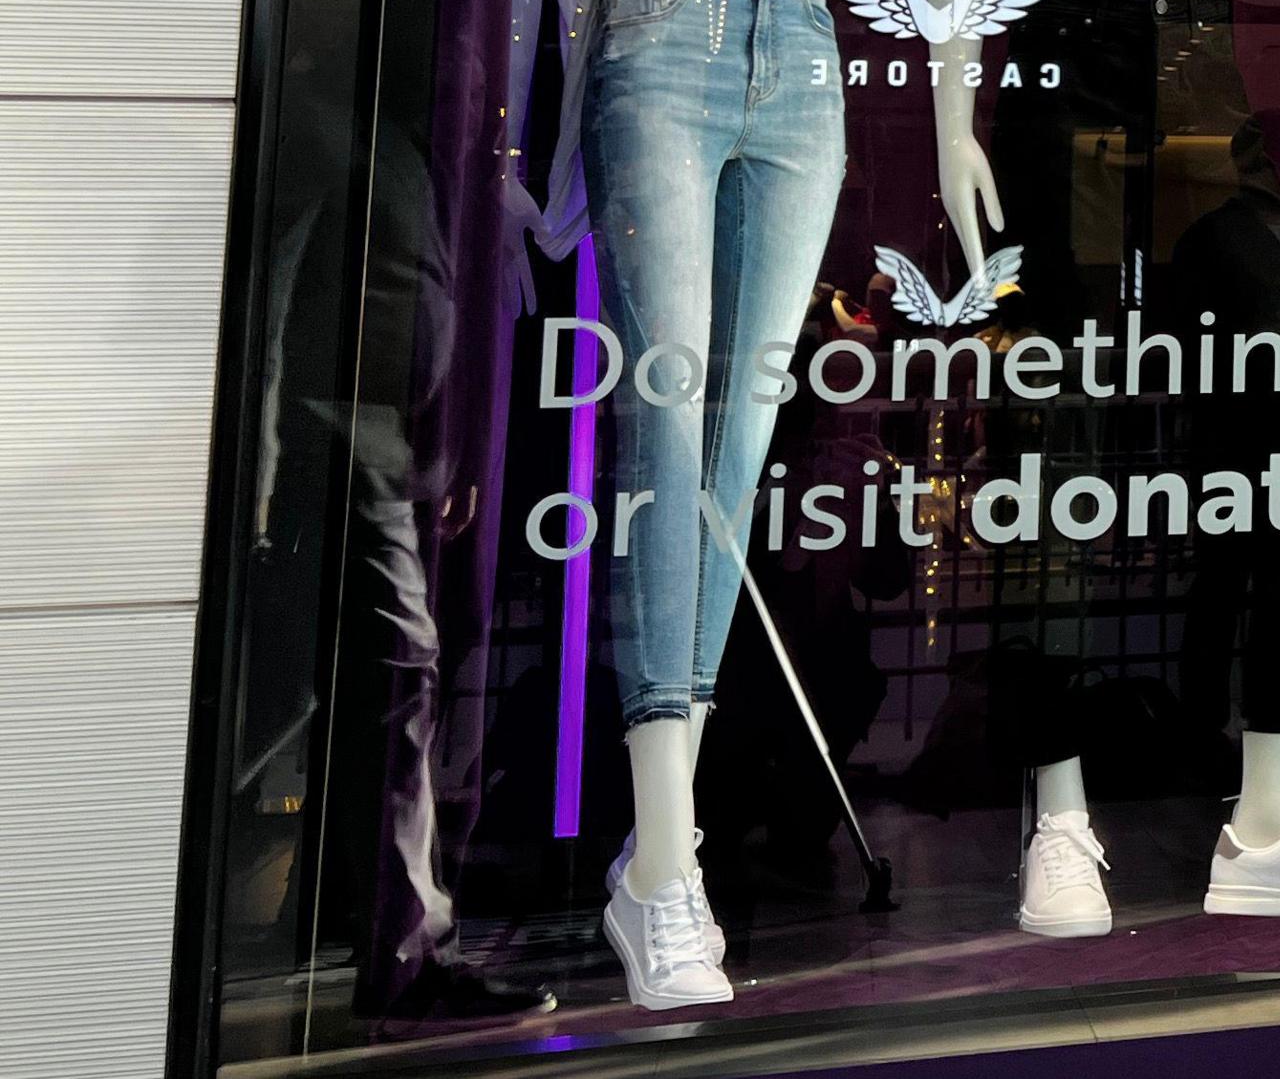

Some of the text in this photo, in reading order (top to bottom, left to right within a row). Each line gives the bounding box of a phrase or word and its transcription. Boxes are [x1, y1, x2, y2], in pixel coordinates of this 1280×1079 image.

[539, 316, 703, 409] Do
[525, 491, 656, 561] or
[700, 459, 934, 554] visit
